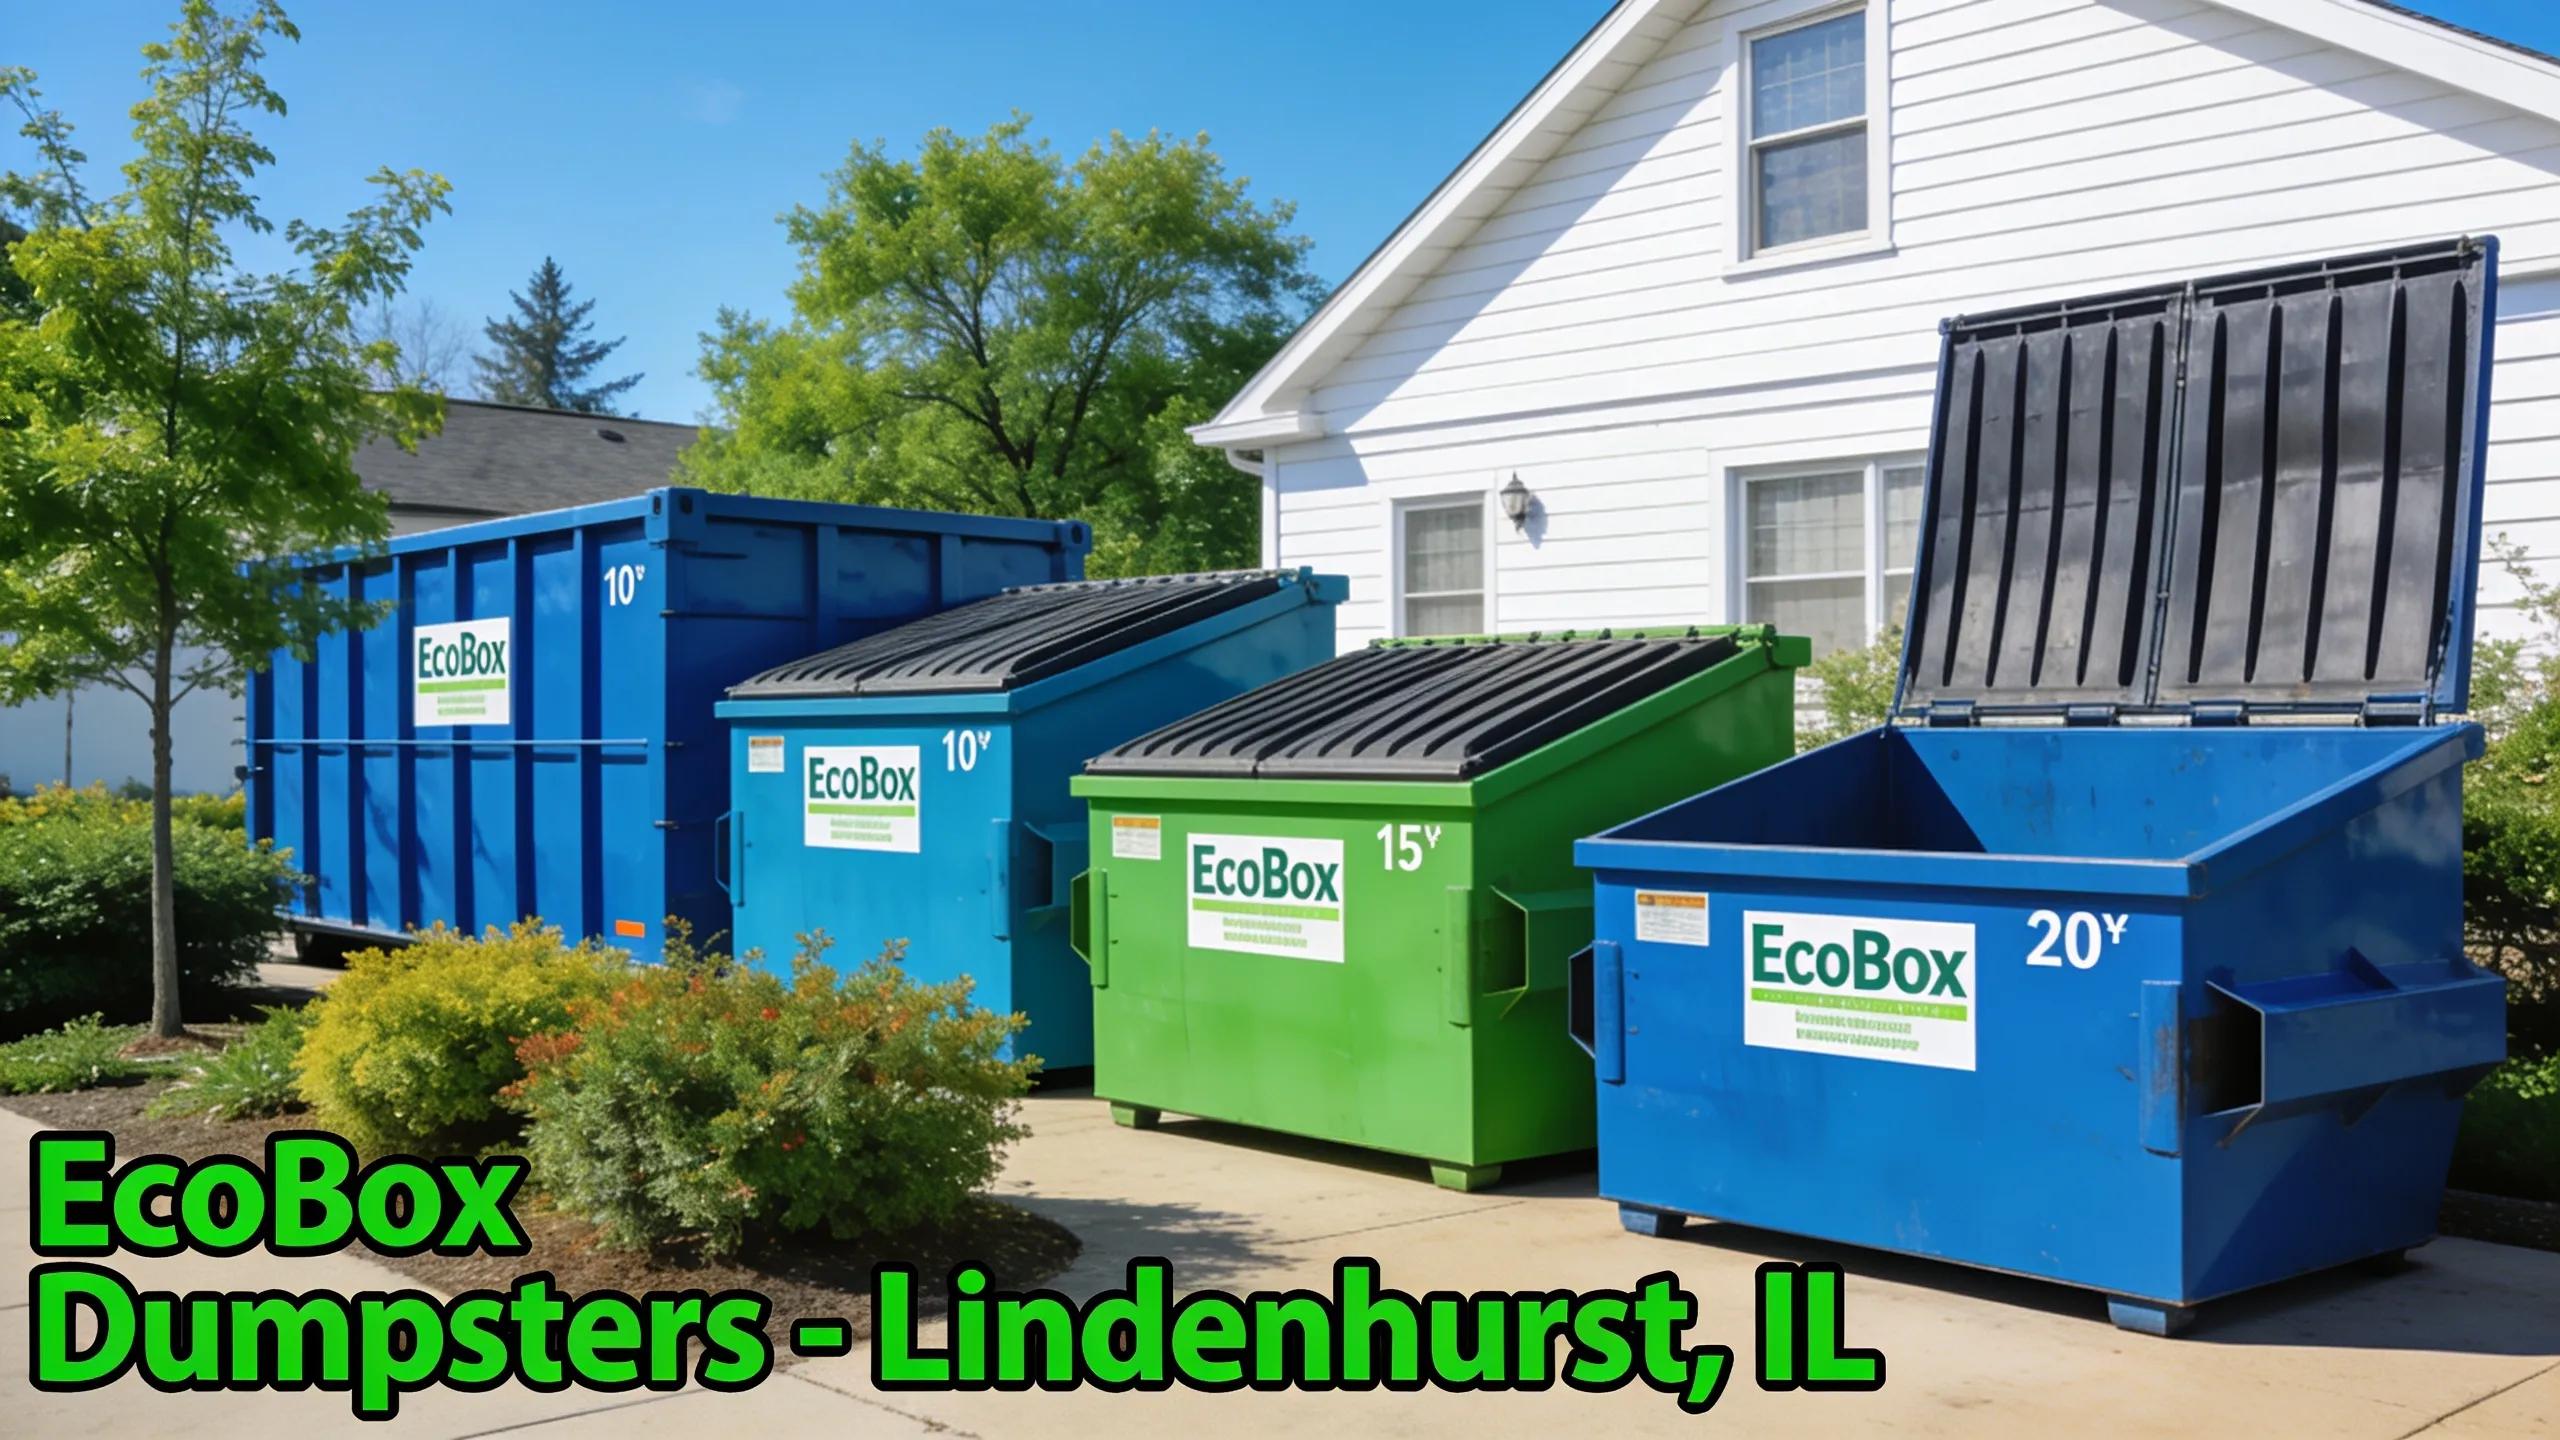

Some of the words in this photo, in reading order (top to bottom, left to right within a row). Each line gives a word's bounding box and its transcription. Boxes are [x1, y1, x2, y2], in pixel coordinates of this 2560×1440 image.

[419, 631, 506, 678] EcoBox
[809, 755, 916, 801] EcoBox
[1192, 843, 1339, 902] EcoBox
[1752, 923, 1968, 998] EcoBox
